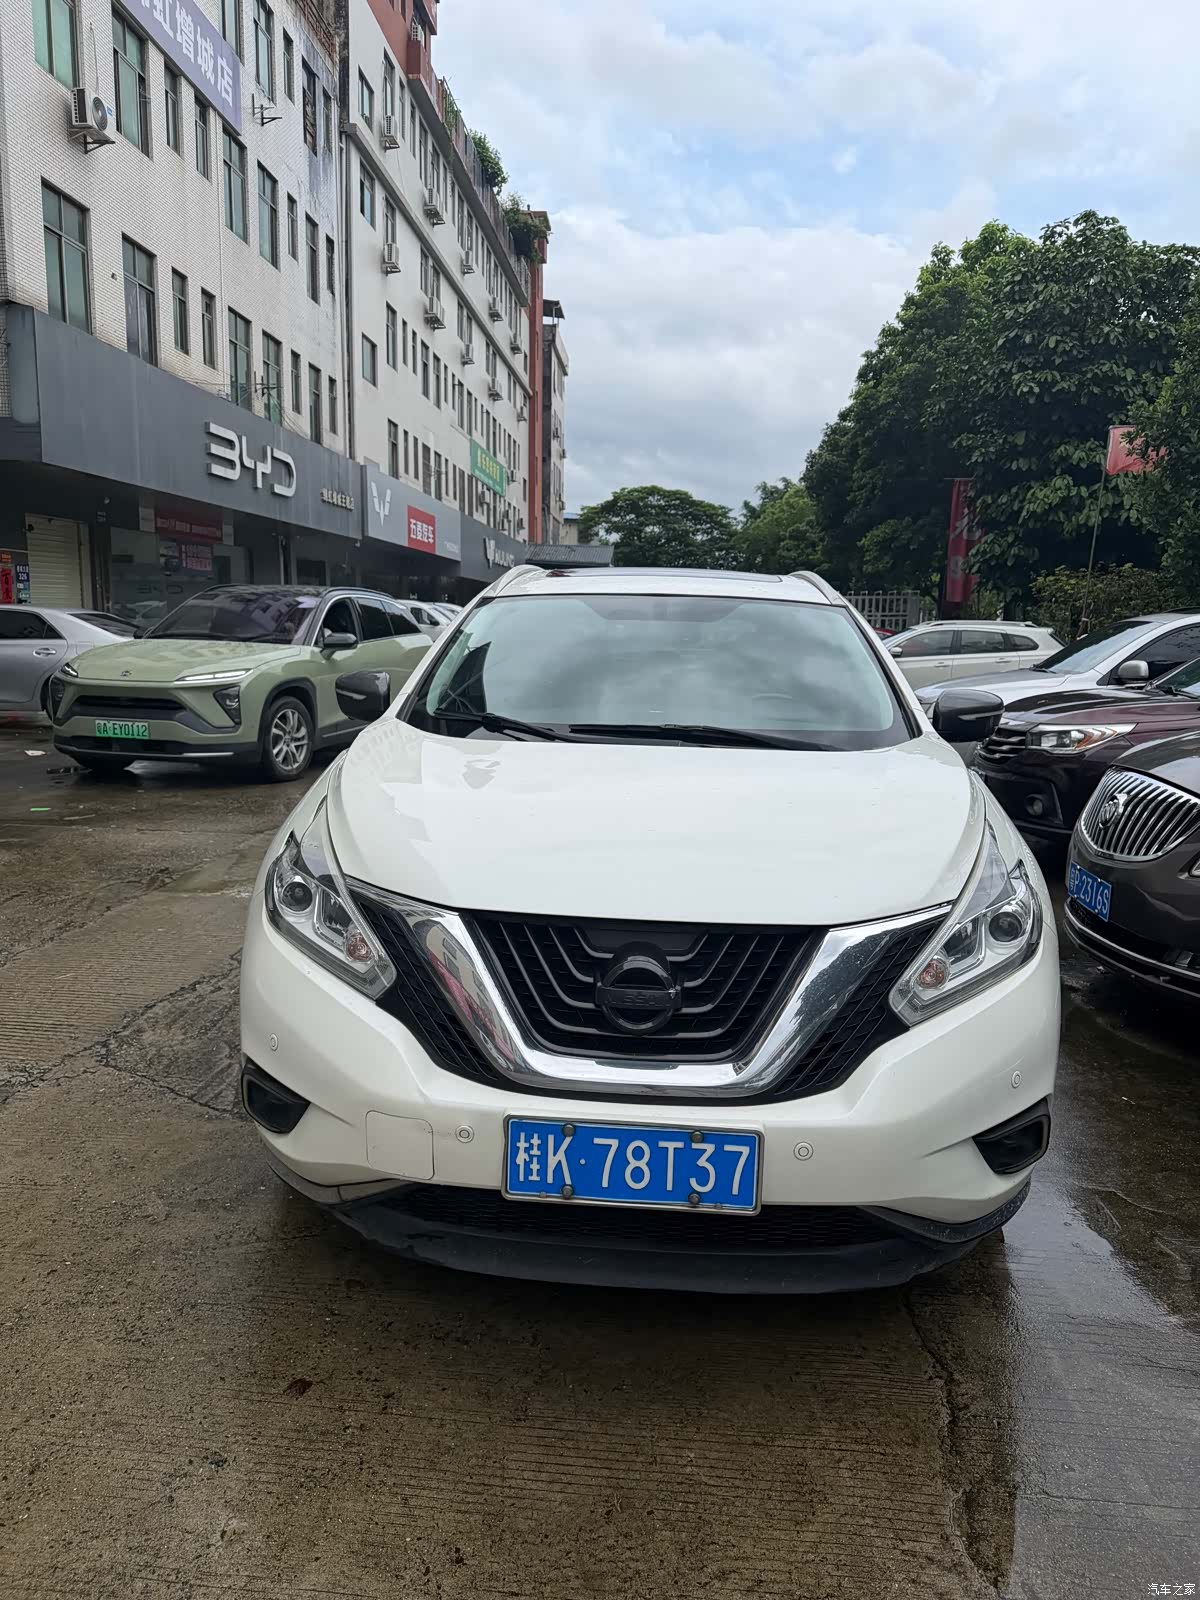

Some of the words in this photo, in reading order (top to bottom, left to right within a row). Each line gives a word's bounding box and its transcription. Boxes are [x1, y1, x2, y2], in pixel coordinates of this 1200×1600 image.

[141, 0, 233, 107] 虹增城店
[204, 421, 297, 497] BYD
[410, 518, 434, 544] 五菱汽车
